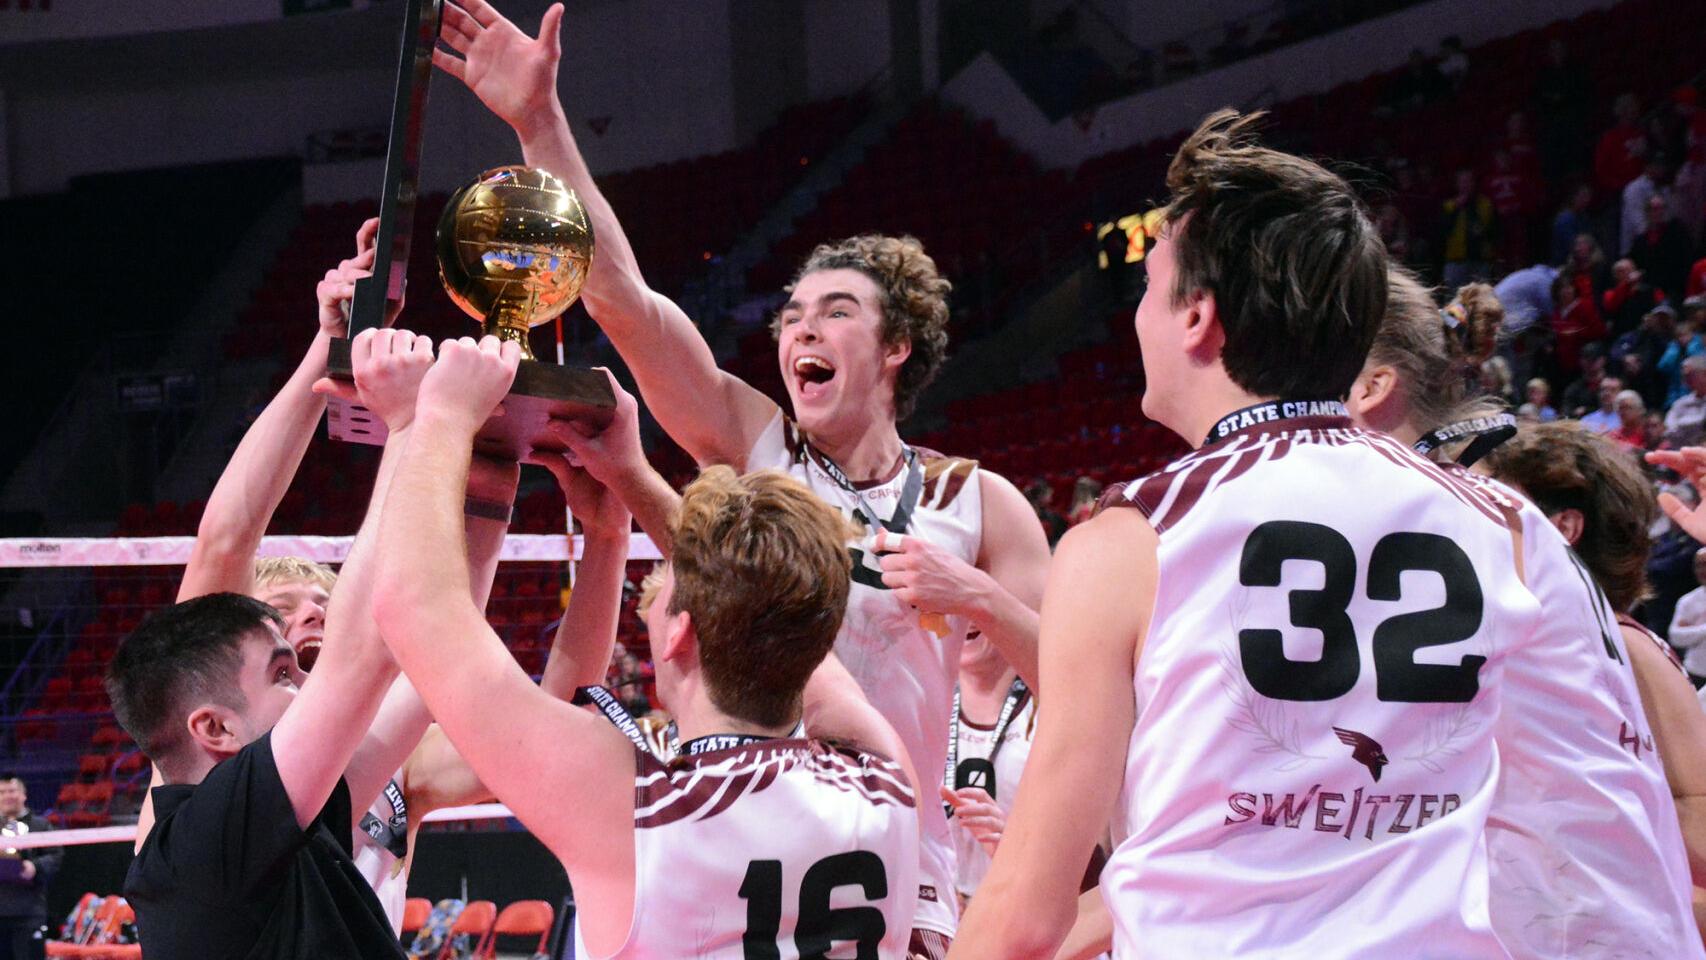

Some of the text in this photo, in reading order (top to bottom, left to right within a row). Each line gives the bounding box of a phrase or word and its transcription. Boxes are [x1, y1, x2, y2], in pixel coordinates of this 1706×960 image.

[1217, 404, 1280, 437] STATE
[20, 543, 61, 554] molten
[1239, 520, 1487, 703] 32
[587, 686, 650, 753] STATE CHAMPIO
[690, 737, 739, 755] STATE
[738, 850, 888, 960] 16
